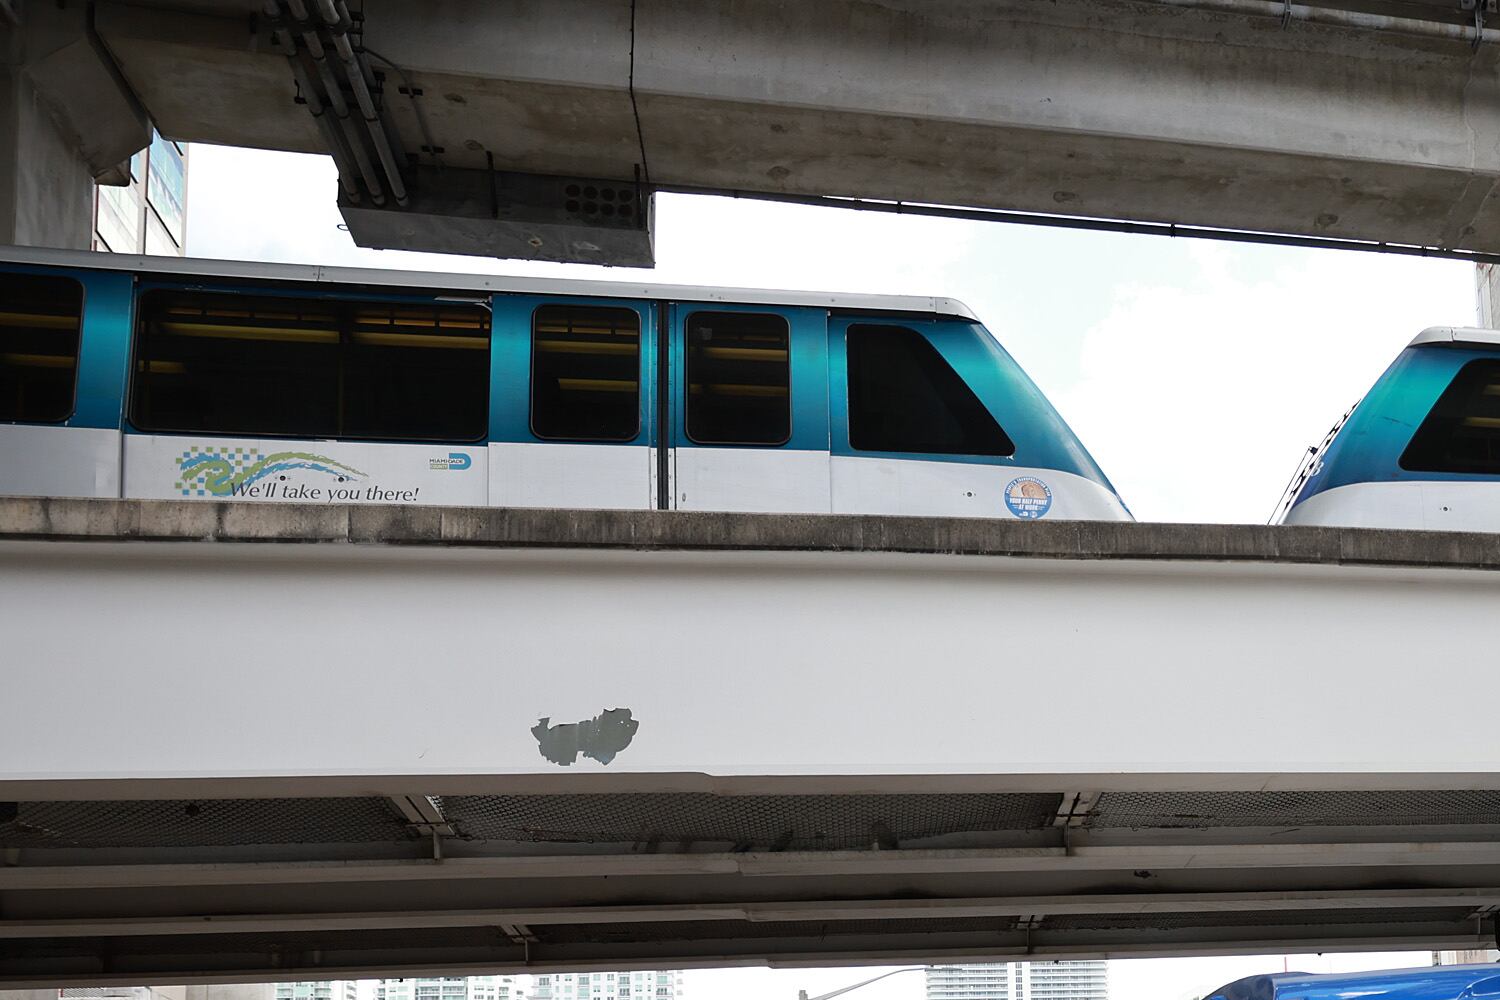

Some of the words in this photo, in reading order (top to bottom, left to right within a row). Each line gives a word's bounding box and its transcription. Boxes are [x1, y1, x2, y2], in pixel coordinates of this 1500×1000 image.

[231, 482, 278, 498] We'll
[282, 484, 321, 500] take
[327, 487, 360, 503] you
[365, 486, 420, 502] there!
